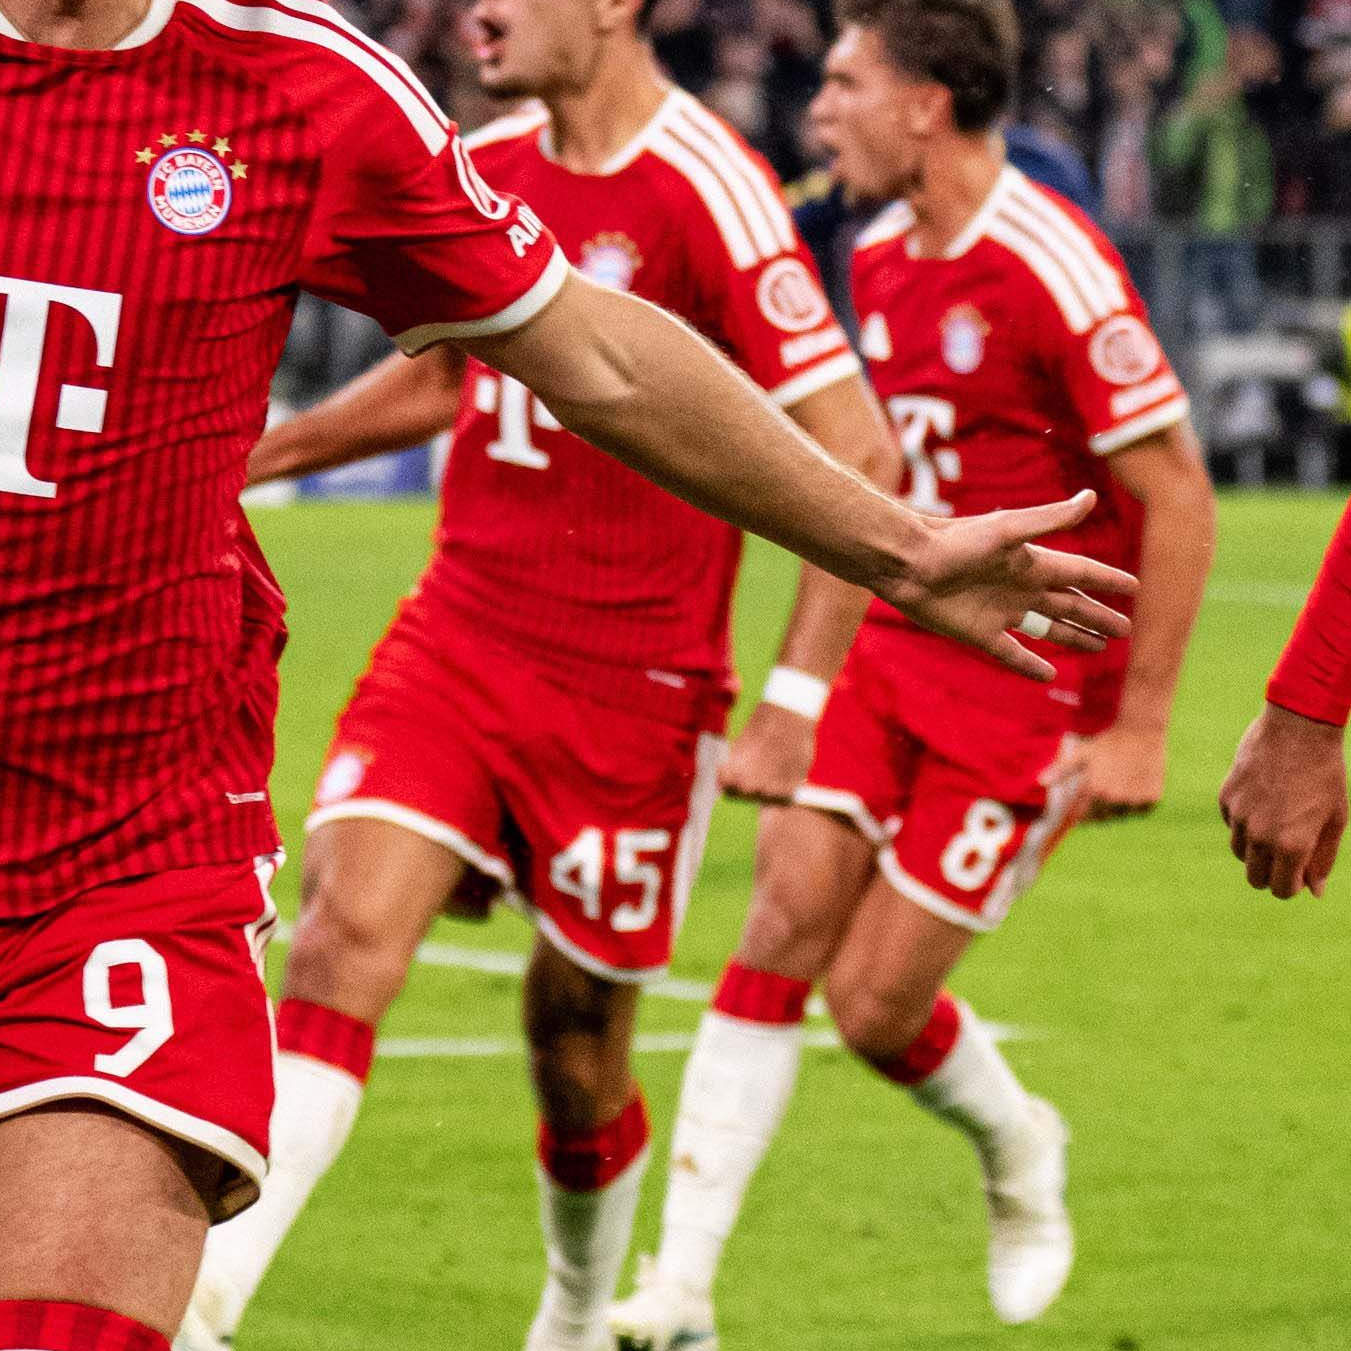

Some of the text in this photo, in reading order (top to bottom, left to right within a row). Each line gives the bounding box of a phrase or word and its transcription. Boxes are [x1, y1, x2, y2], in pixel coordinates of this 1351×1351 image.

[549, 825, 671, 932] 45
[939, 798, 1016, 891] 8
[82, 937, 175, 1078] 9
